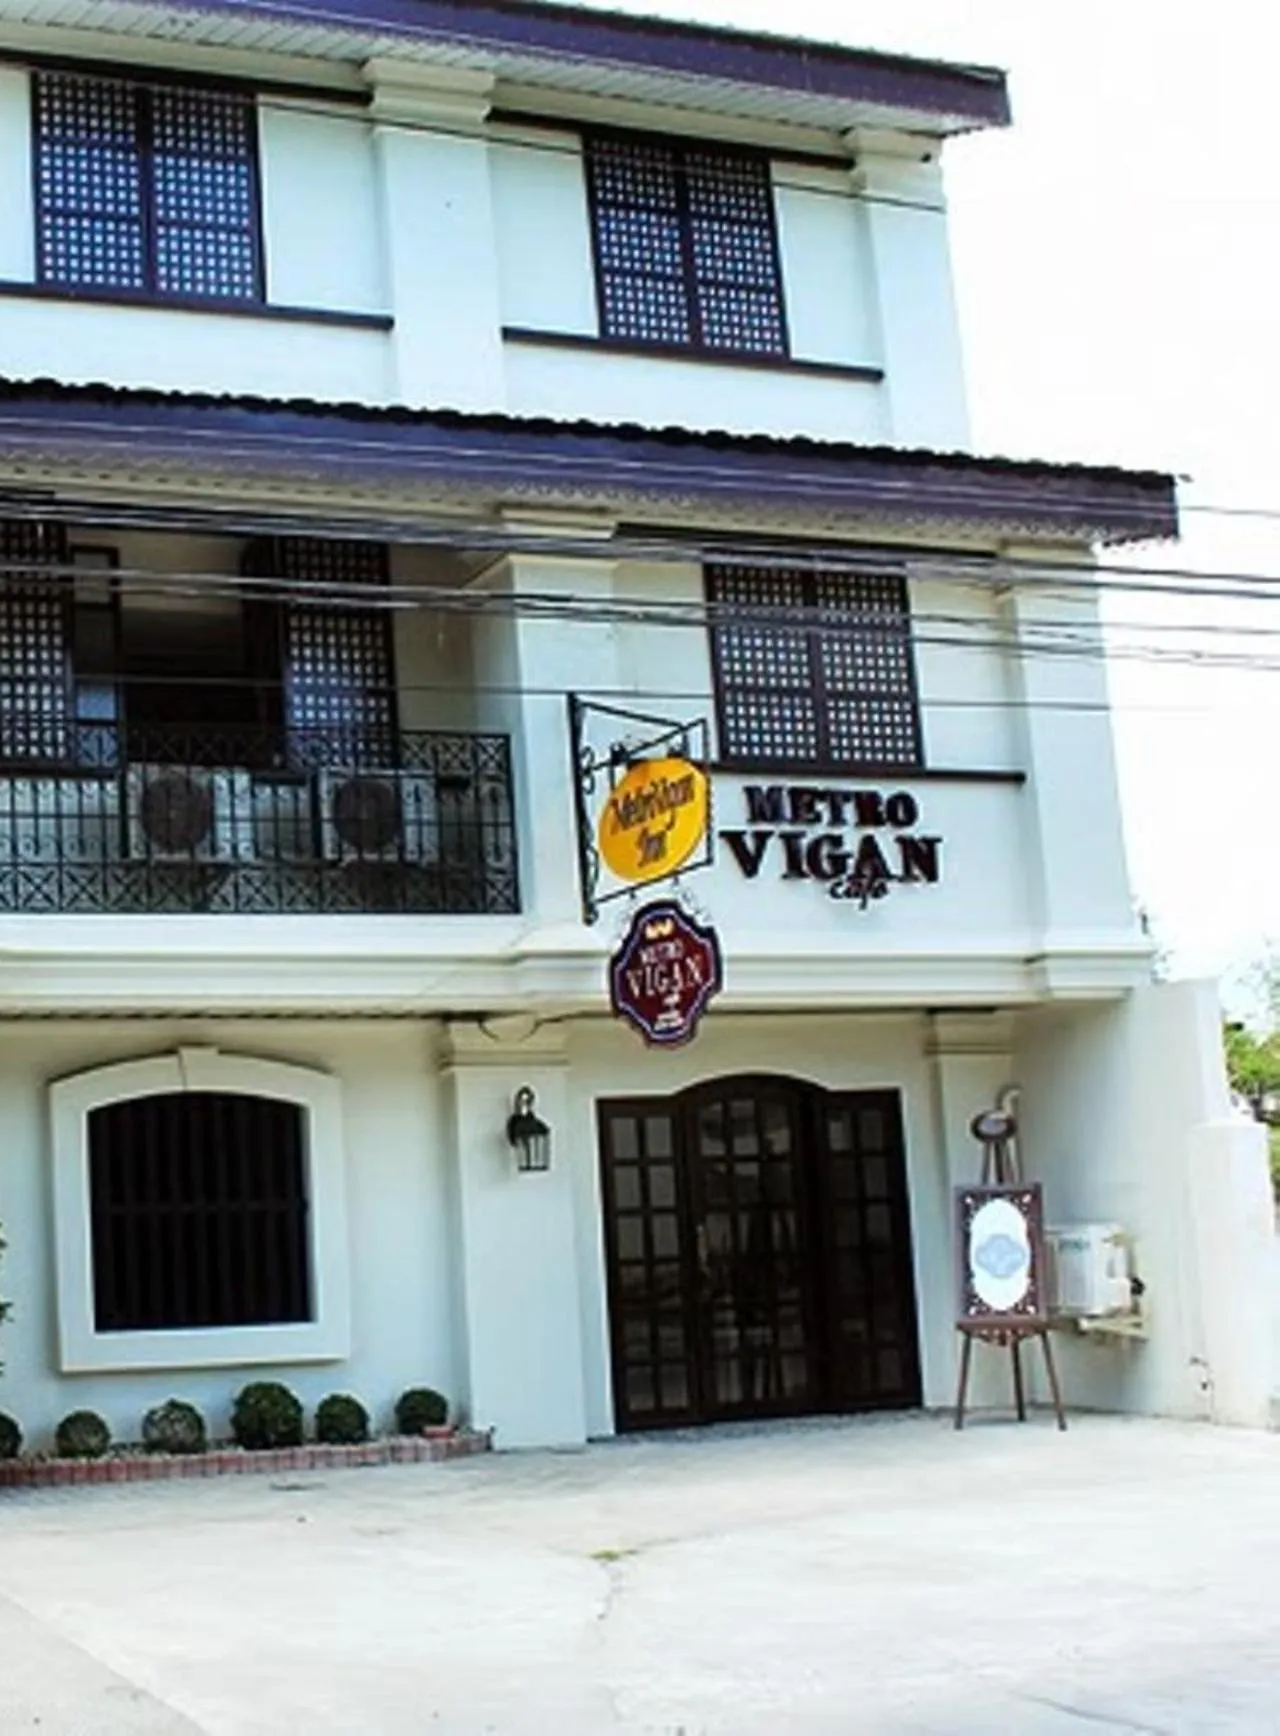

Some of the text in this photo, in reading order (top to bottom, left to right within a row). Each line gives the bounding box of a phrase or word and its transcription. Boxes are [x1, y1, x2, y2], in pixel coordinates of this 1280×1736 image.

[743, 784, 919, 828] METRO
[718, 830, 943, 883] VIGAN
[625, 953, 706, 998] VIGAN
